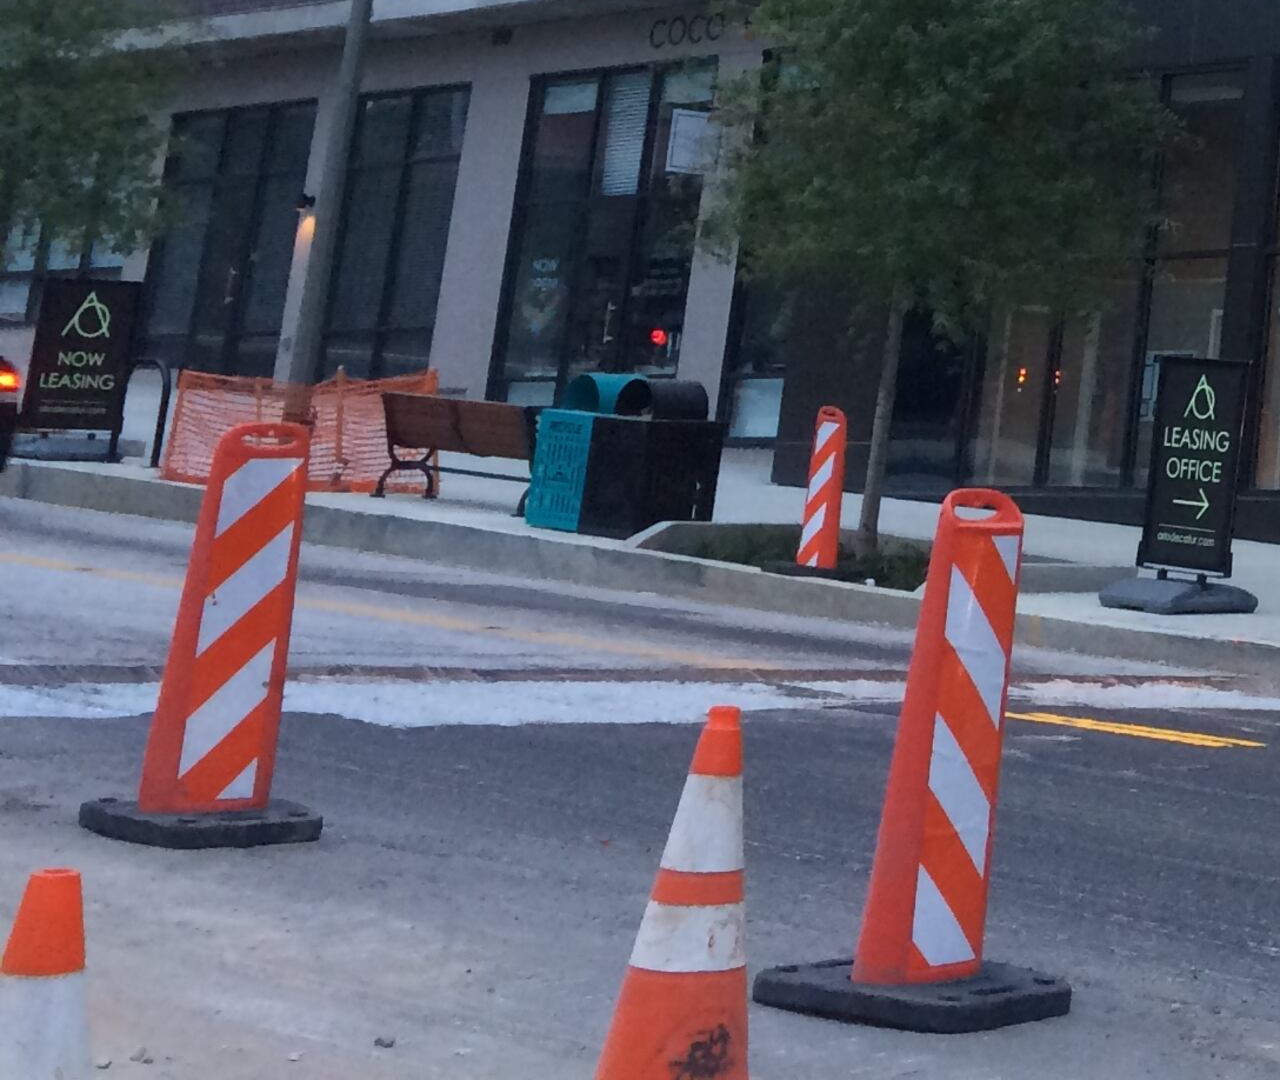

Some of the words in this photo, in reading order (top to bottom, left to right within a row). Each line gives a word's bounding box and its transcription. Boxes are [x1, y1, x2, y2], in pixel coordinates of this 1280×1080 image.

[650, 12, 725, 48] COCO
[57, 351, 105, 367] NOW
[39, 372, 115, 390] LEASING
[1164, 426, 1230, 452] LEASING
[1166, 457, 1222, 482] OFFICE
